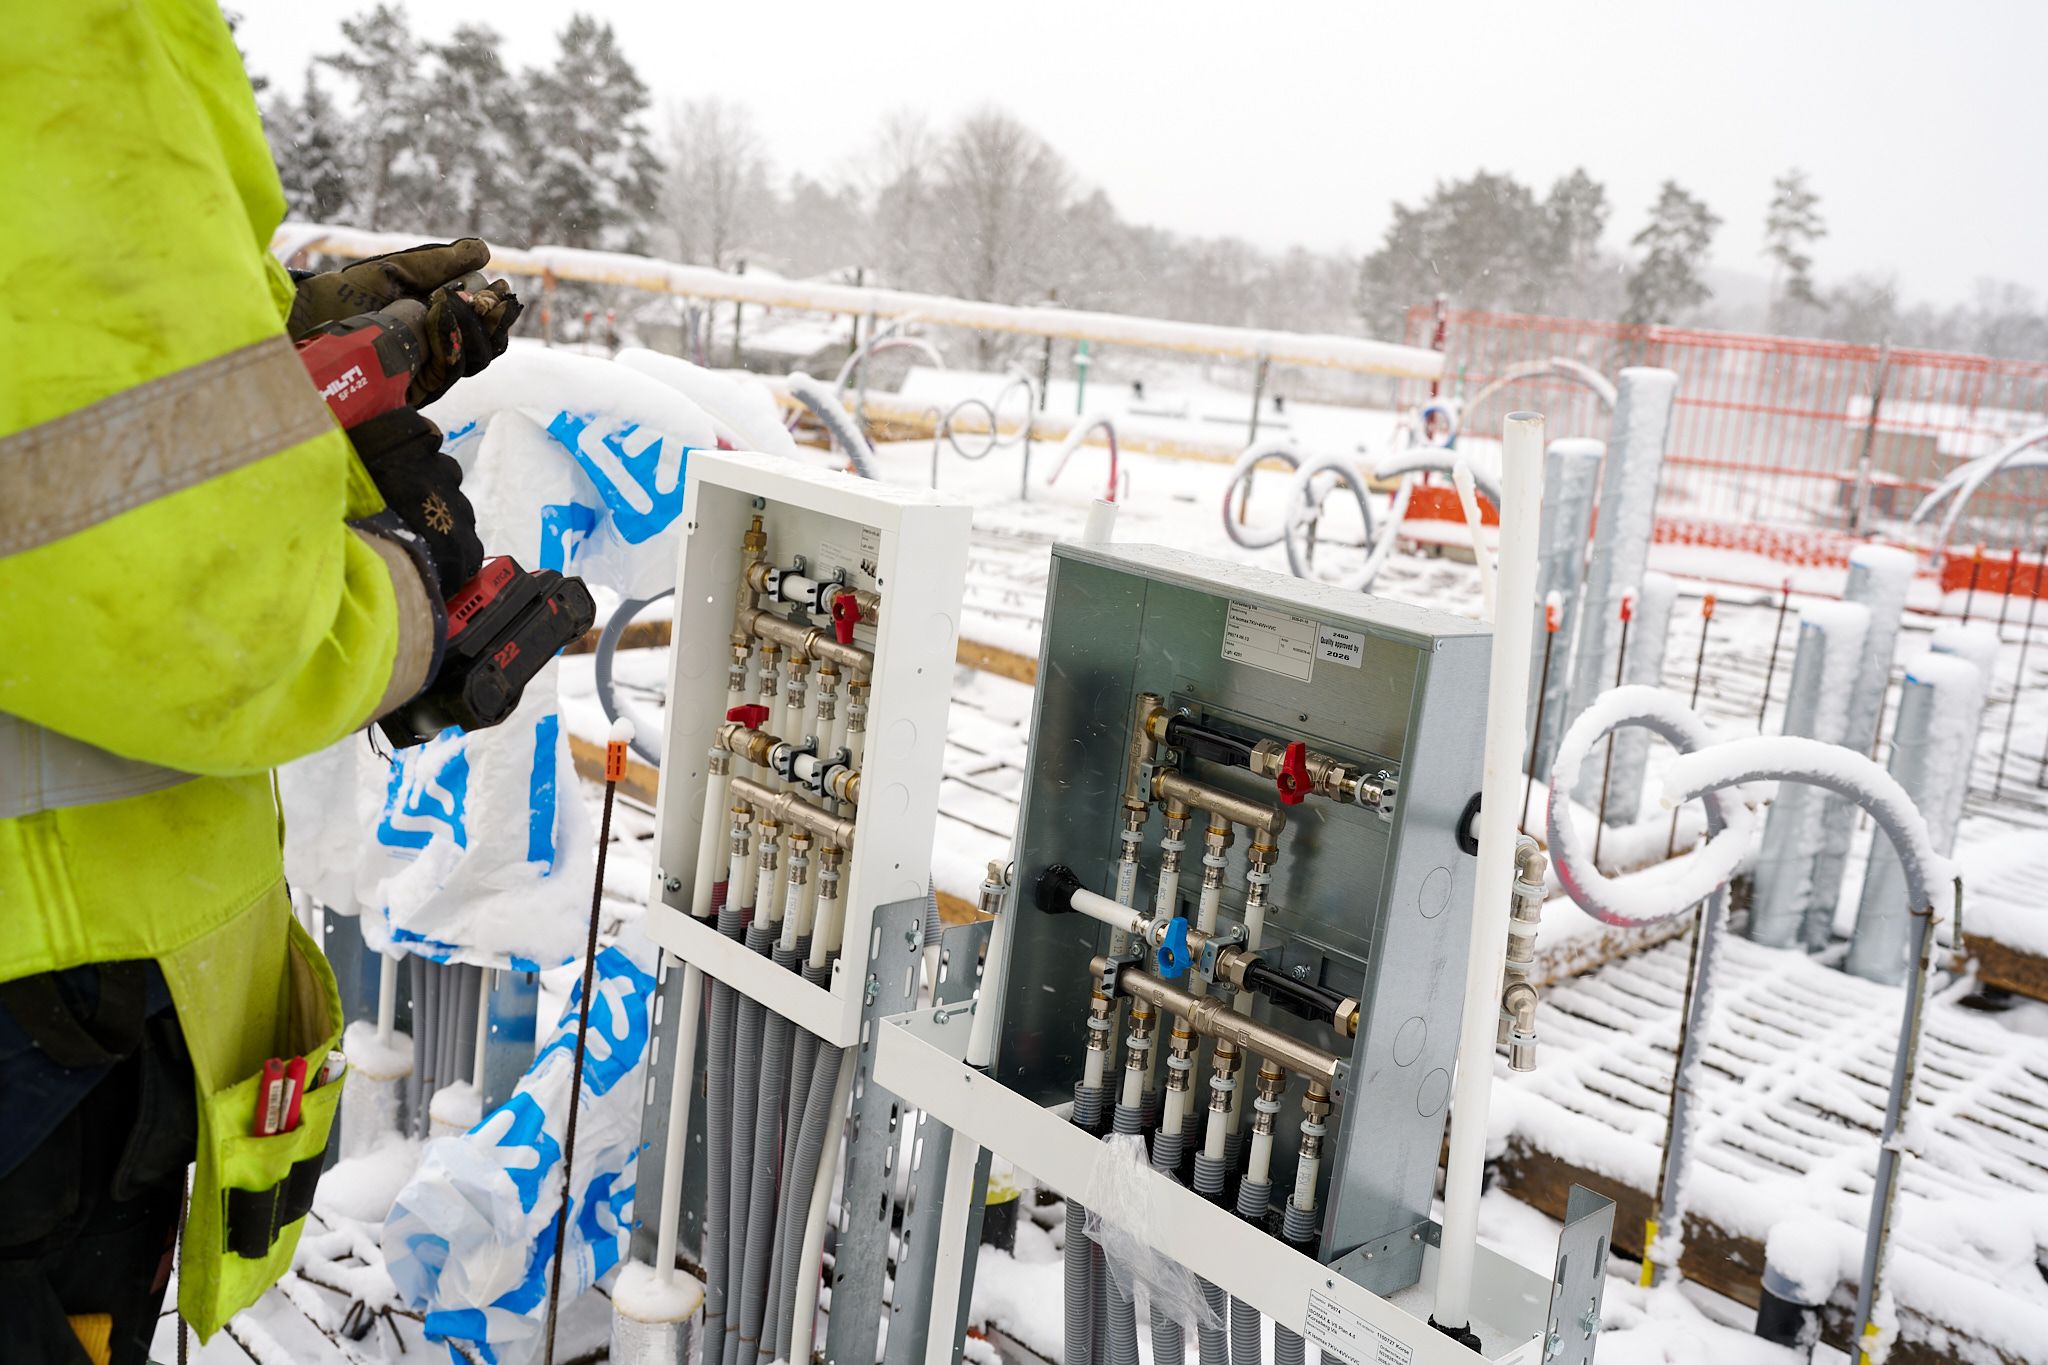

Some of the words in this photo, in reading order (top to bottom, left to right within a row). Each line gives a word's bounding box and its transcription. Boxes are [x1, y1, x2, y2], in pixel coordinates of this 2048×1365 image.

[319, 365, 363, 401] HILTI
[338, 389, 350, 401] SF
[349, 377, 368, 394] 4-22
[494, 640, 521, 670] 22
[1320, 636, 1334, 647] Quality
[1334, 640, 1354, 651] approved
[1353, 645, 1360, 653] by
[1326, 650, 1350, 661] 2026
